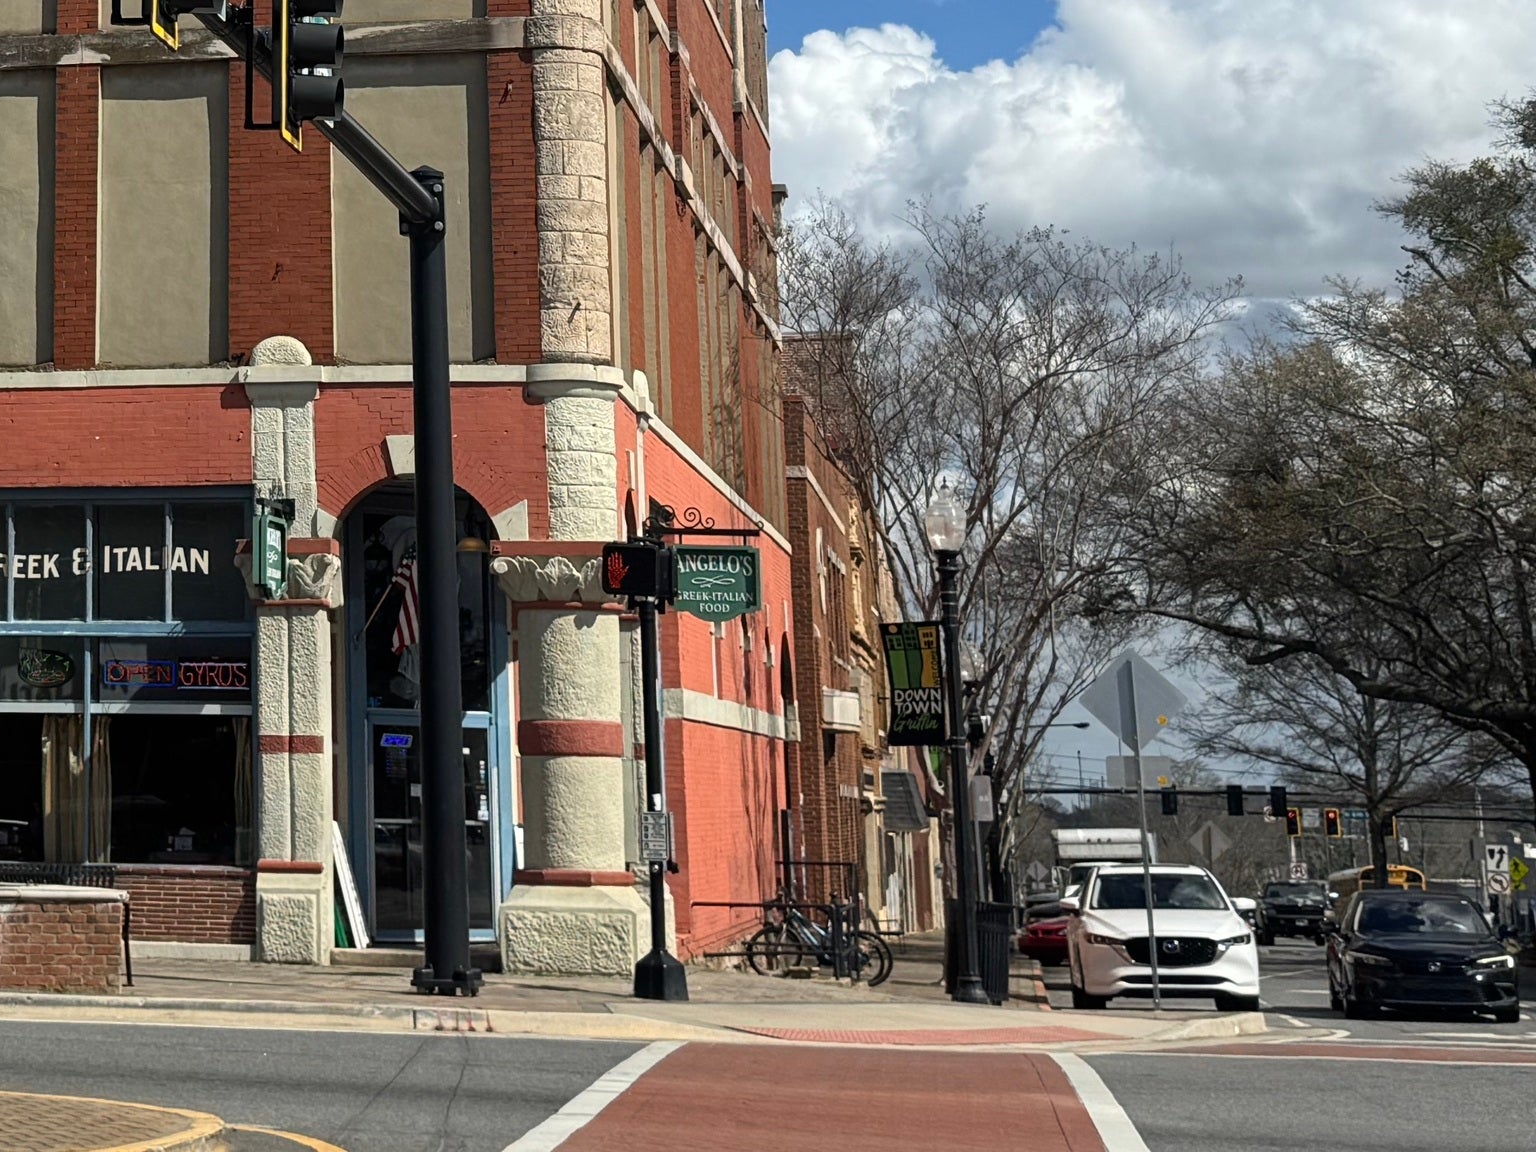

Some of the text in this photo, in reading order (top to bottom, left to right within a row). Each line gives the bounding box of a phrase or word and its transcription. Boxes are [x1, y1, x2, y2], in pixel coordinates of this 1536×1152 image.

[72, 547, 92, 576] &
[103, 545, 209, 575] ITALIAN
[677, 554, 753, 576] ANGELO'S
[699, 602, 730, 613] FOOD
[109, 663, 247, 687] OPEN GYROS
[894, 689, 941, 702] DOWN
[894, 701, 942, 714] TOWN
[893, 712, 939, 733] Griffin
